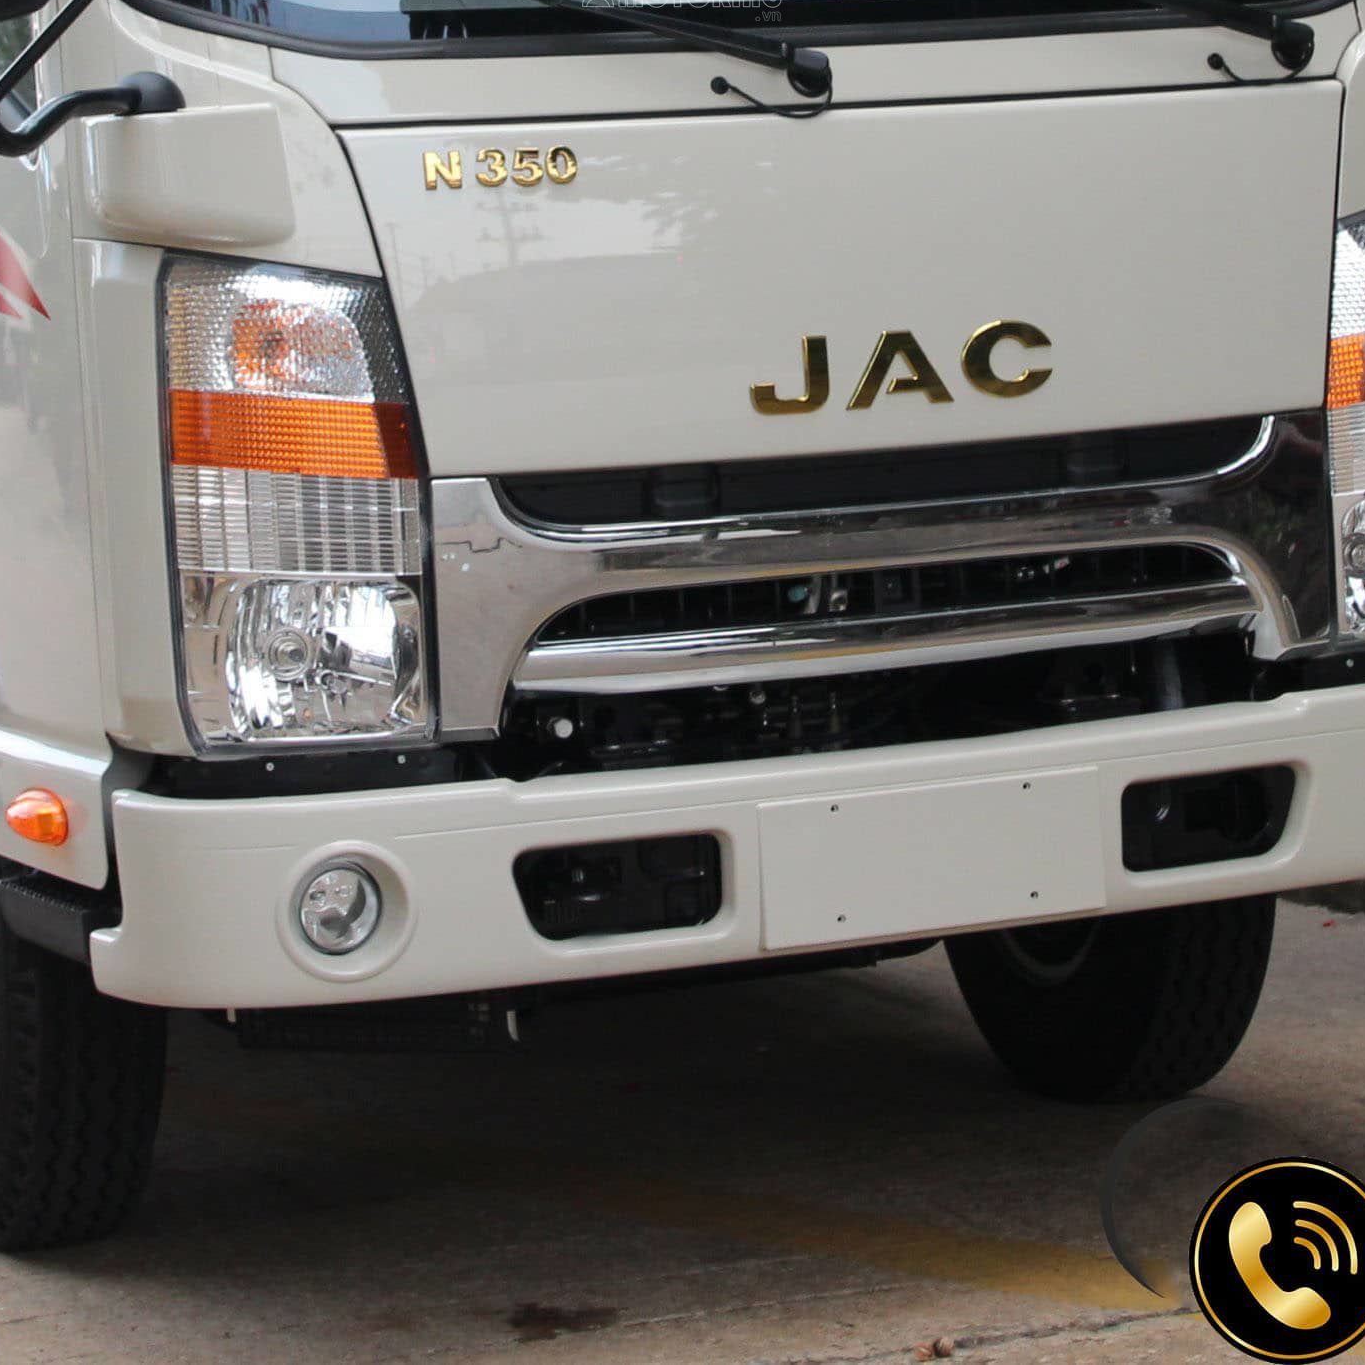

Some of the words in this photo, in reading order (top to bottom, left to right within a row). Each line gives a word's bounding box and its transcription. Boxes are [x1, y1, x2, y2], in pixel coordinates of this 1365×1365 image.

[423, 149, 463, 191] N
[475, 145, 579, 188] 350
[749, 319, 1054, 416] JAC
